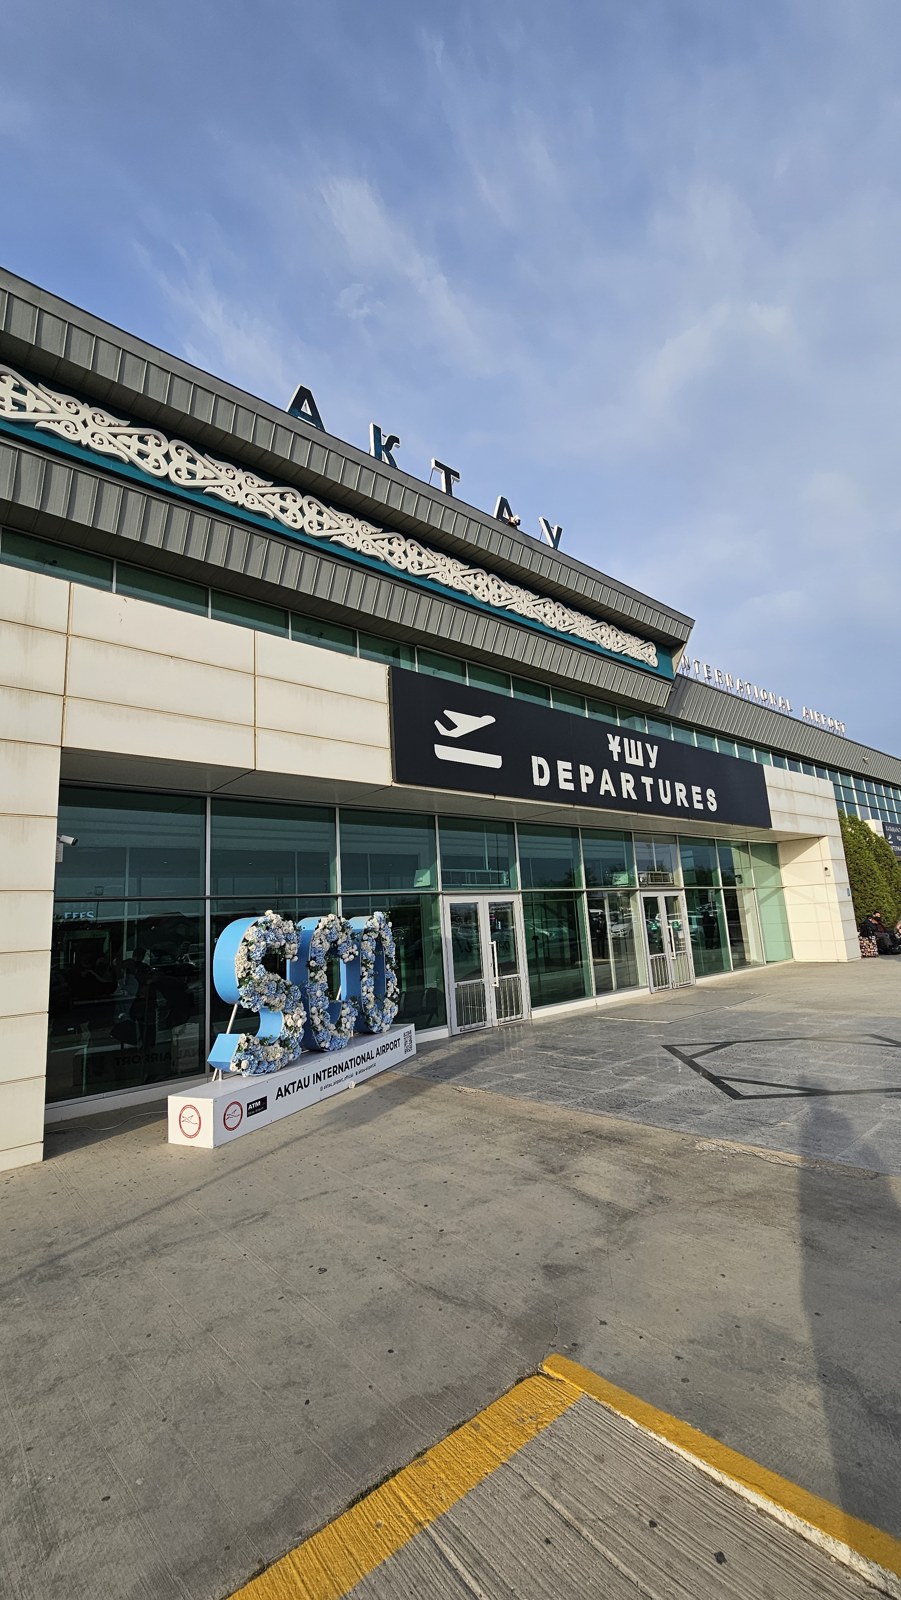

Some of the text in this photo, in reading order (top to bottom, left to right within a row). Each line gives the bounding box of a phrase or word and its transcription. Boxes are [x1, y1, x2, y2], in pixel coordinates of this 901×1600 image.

[681, 655, 846, 733] NTERNATIONAL AIRPORT
[606, 733, 659, 769] ҰШУ
[531, 755, 718, 812] DEPARTURES
[275, 1037, 401, 1100] AKTAU INTERNATIONAL AIRPORT
[247, 1100, 261, 1111] ATM
